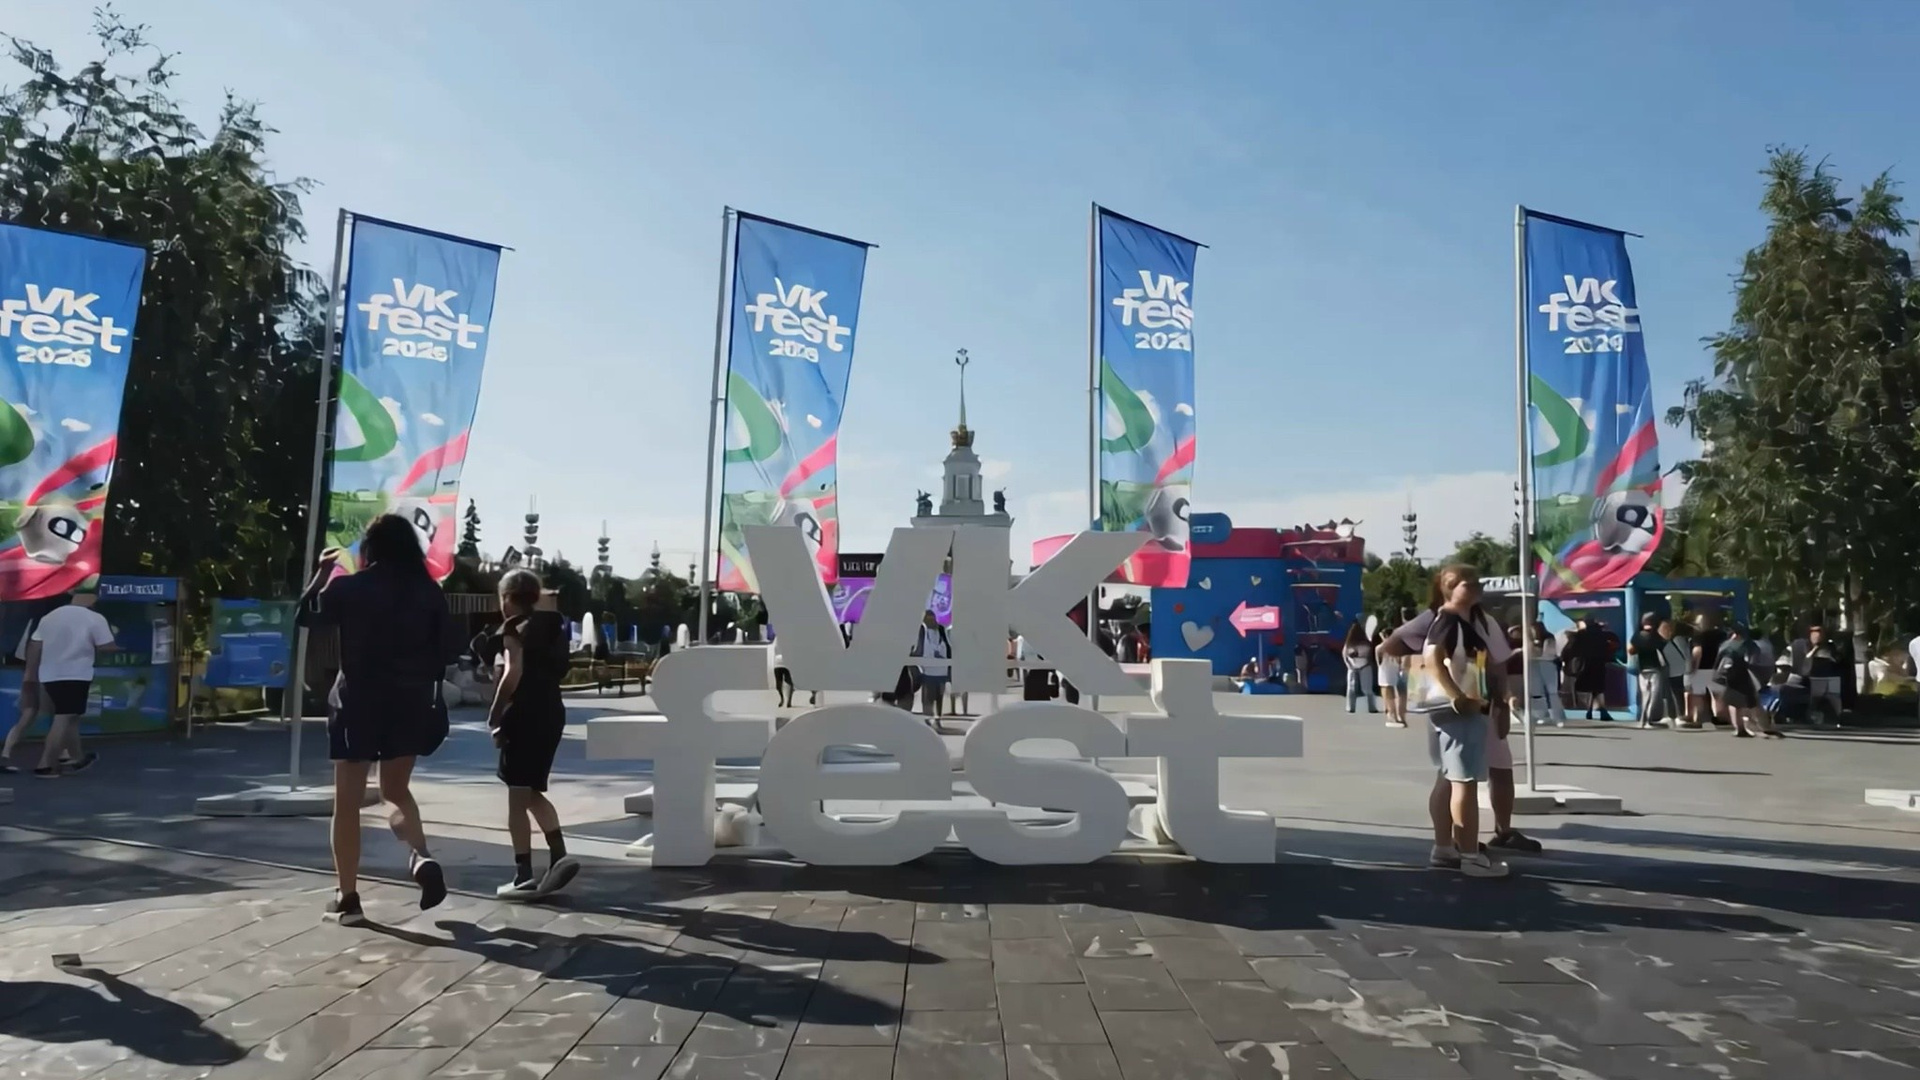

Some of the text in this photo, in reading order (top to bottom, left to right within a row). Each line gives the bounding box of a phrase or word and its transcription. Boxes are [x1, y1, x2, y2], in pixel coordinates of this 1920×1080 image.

[25, 283, 100, 322] VK
[392, 277, 458, 319] VK
[774, 276, 828, 321] VK
[1112, 288, 1195, 330] fes
[1138, 270, 1190, 308] VK
[1563, 274, 1623, 305] VK
[0, 299, 129, 354] fest
[357, 293, 485, 350] fest
[744, 293, 851, 352] fest
[742, 525, 1152, 695] VK
[586, 643, 1304, 866] fest
